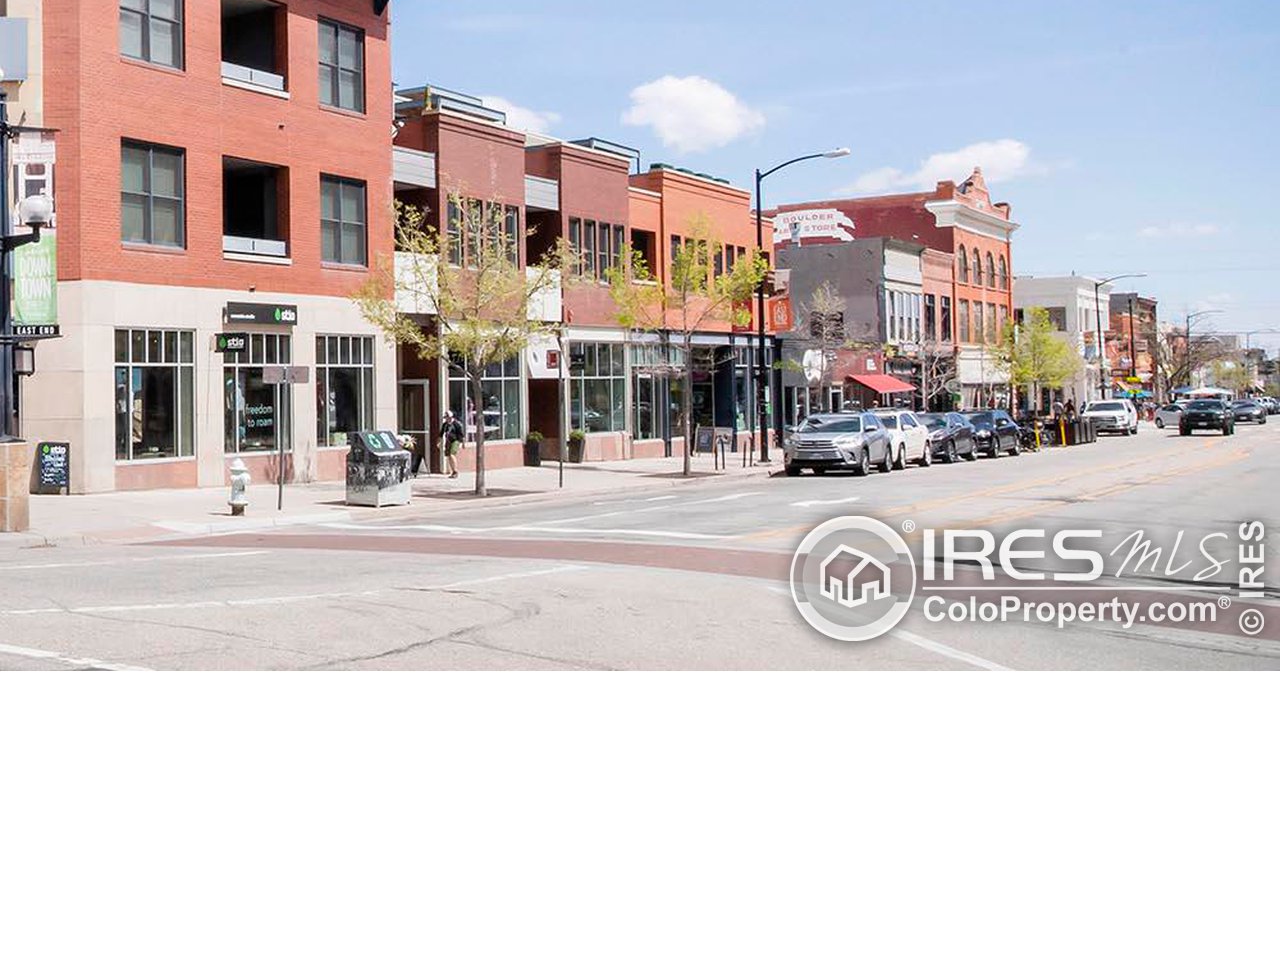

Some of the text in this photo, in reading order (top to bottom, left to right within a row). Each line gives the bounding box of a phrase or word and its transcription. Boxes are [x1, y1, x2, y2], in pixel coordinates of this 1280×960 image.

[783, 213, 834, 224] BOULDER
[804, 223, 837, 232] STORE
[20, 257, 51, 277] DOWN
[20, 278, 51, 298] TOWN
[17, 326, 55, 335] EAST END
[245, 402, 273, 415] freedom
